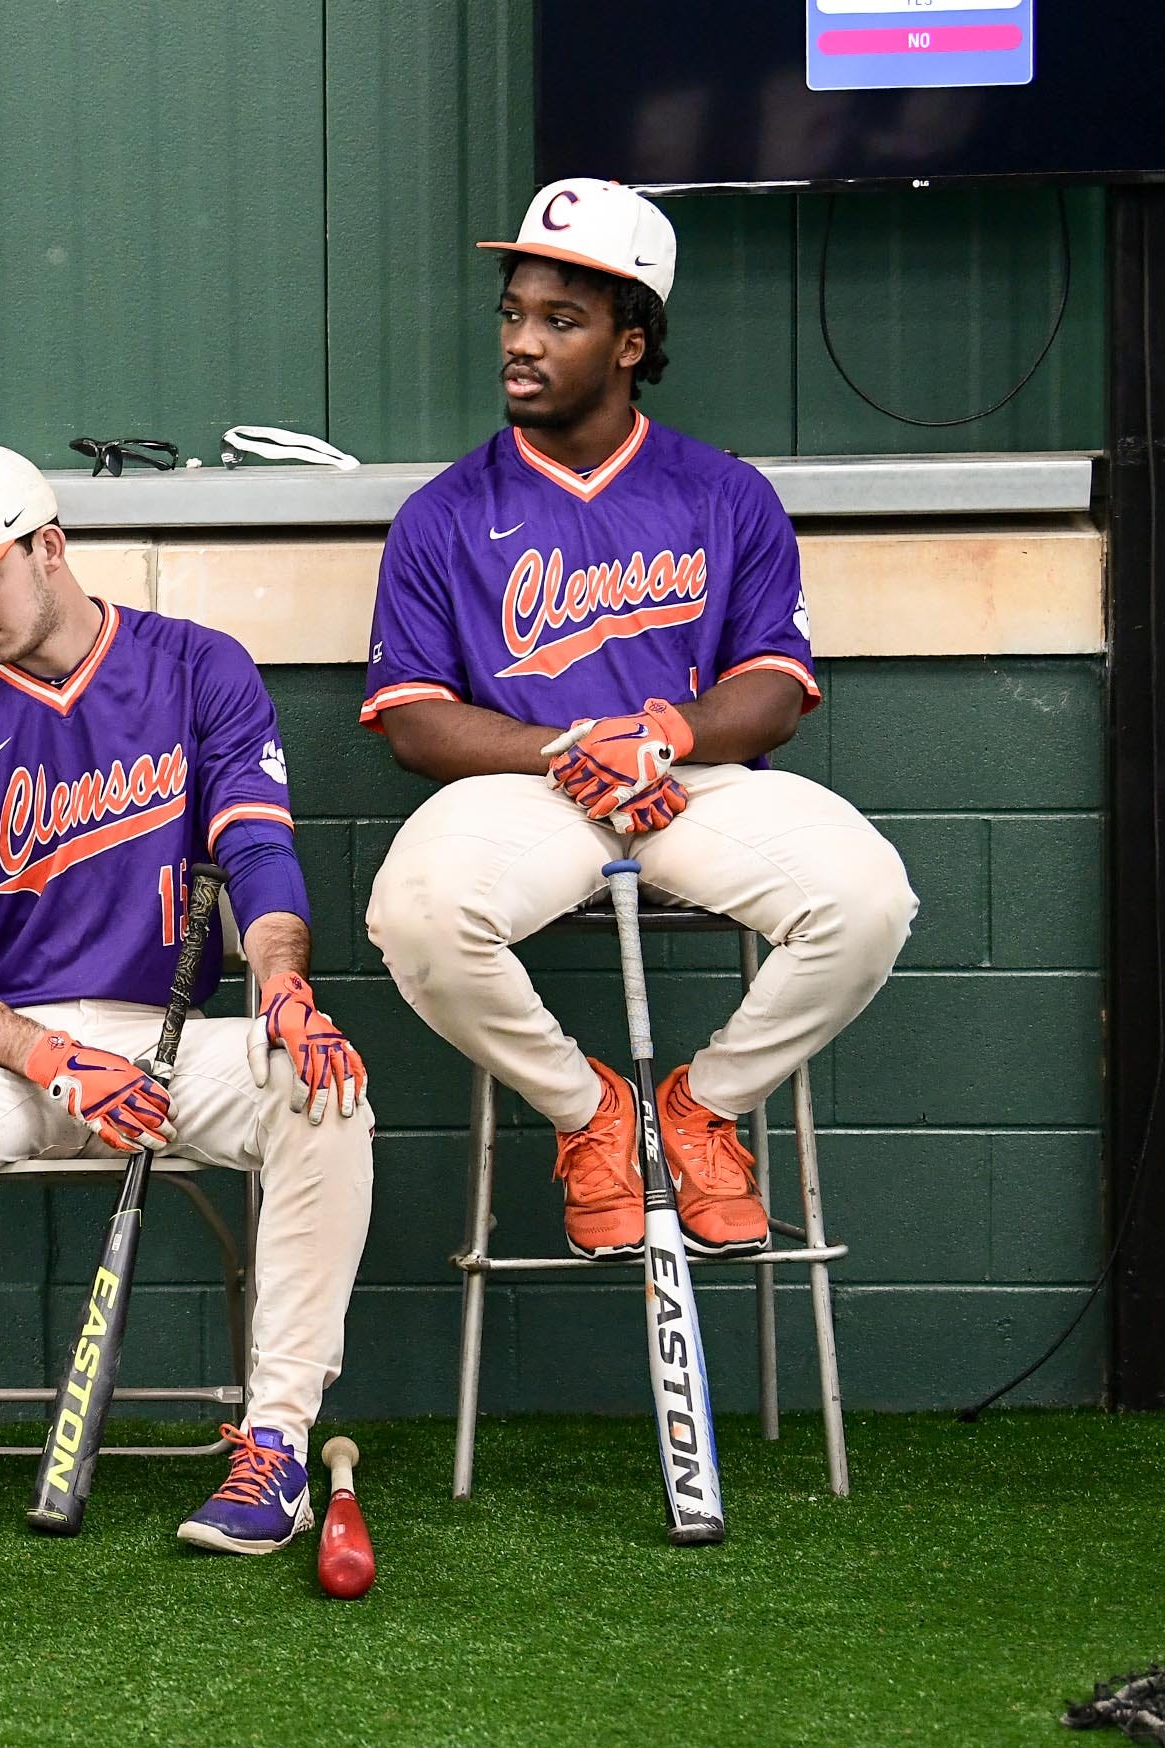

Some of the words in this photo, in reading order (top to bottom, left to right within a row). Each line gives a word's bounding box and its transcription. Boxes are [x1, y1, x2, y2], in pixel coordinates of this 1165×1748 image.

[908, 33, 931, 48] NO
[542, 190, 580, 232] C
[502, 548, 707, 658] Clemson
[47, 1266, 120, 1493] EASTON
[650, 1246, 703, 1500] EASTON
